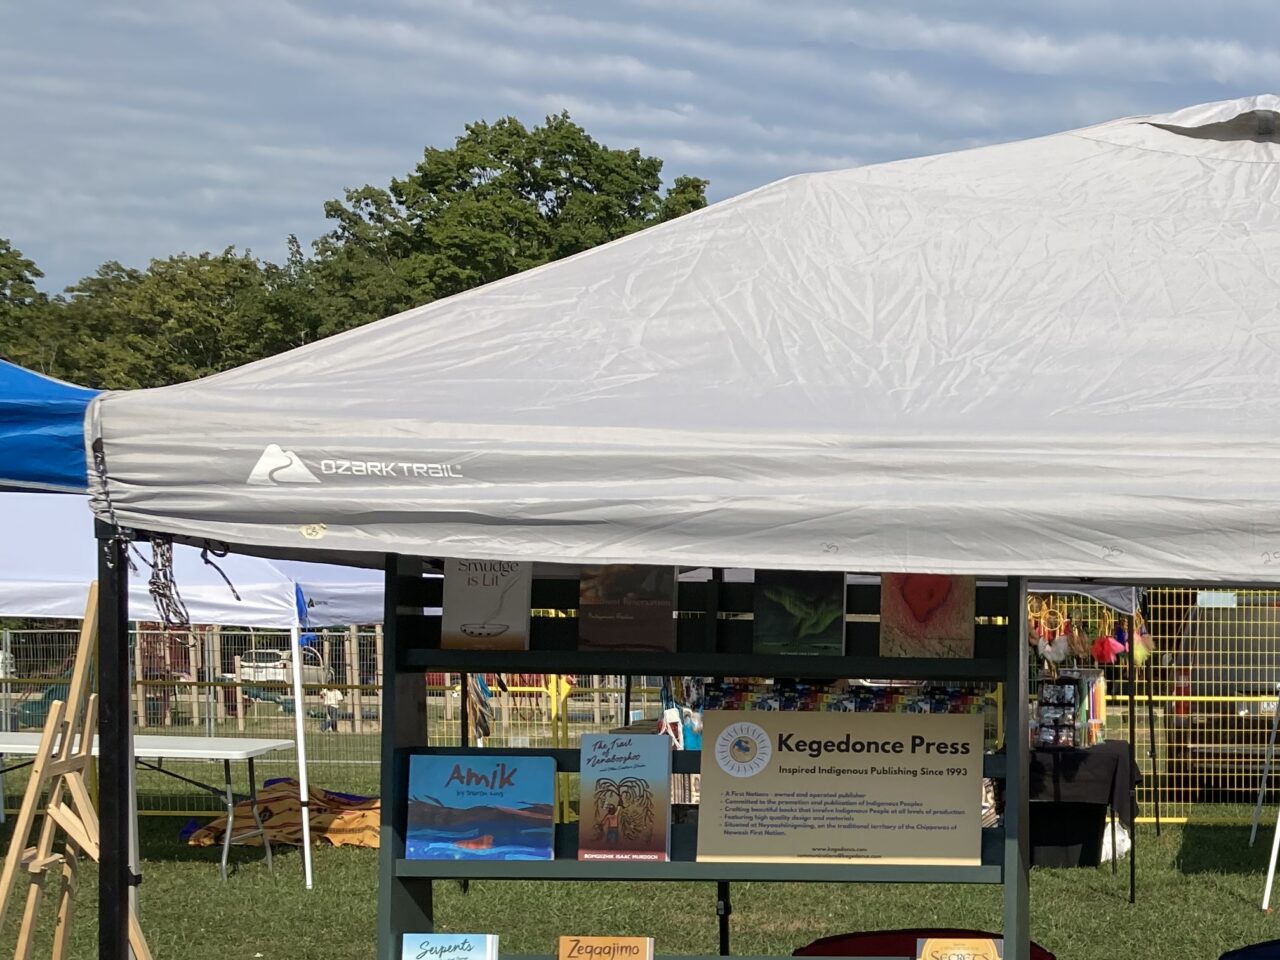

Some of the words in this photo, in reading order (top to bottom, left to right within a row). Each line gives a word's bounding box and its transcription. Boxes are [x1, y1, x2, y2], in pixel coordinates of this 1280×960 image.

[320, 459, 397, 477] OZARK
[398, 462, 464, 478] TRAIL
[458, 559, 519, 577] Smudge
[468, 574, 479, 587] is
[482, 573, 499, 587] Lit
[592, 740, 608, 752] The
[610, 738, 633, 750] Trail
[778, 733, 904, 758] Kegedonce
[911, 735, 971, 755] Press
[444, 763, 517, 789] Amik
[779, 766, 817, 776] Inspired
[818, 766, 869, 777] Indigenous
[870, 767, 918, 778] Publishing
[920, 767, 944, 776] Since
[946, 768, 968, 777] 1993
[416, 938, 474, 960] Serpents
